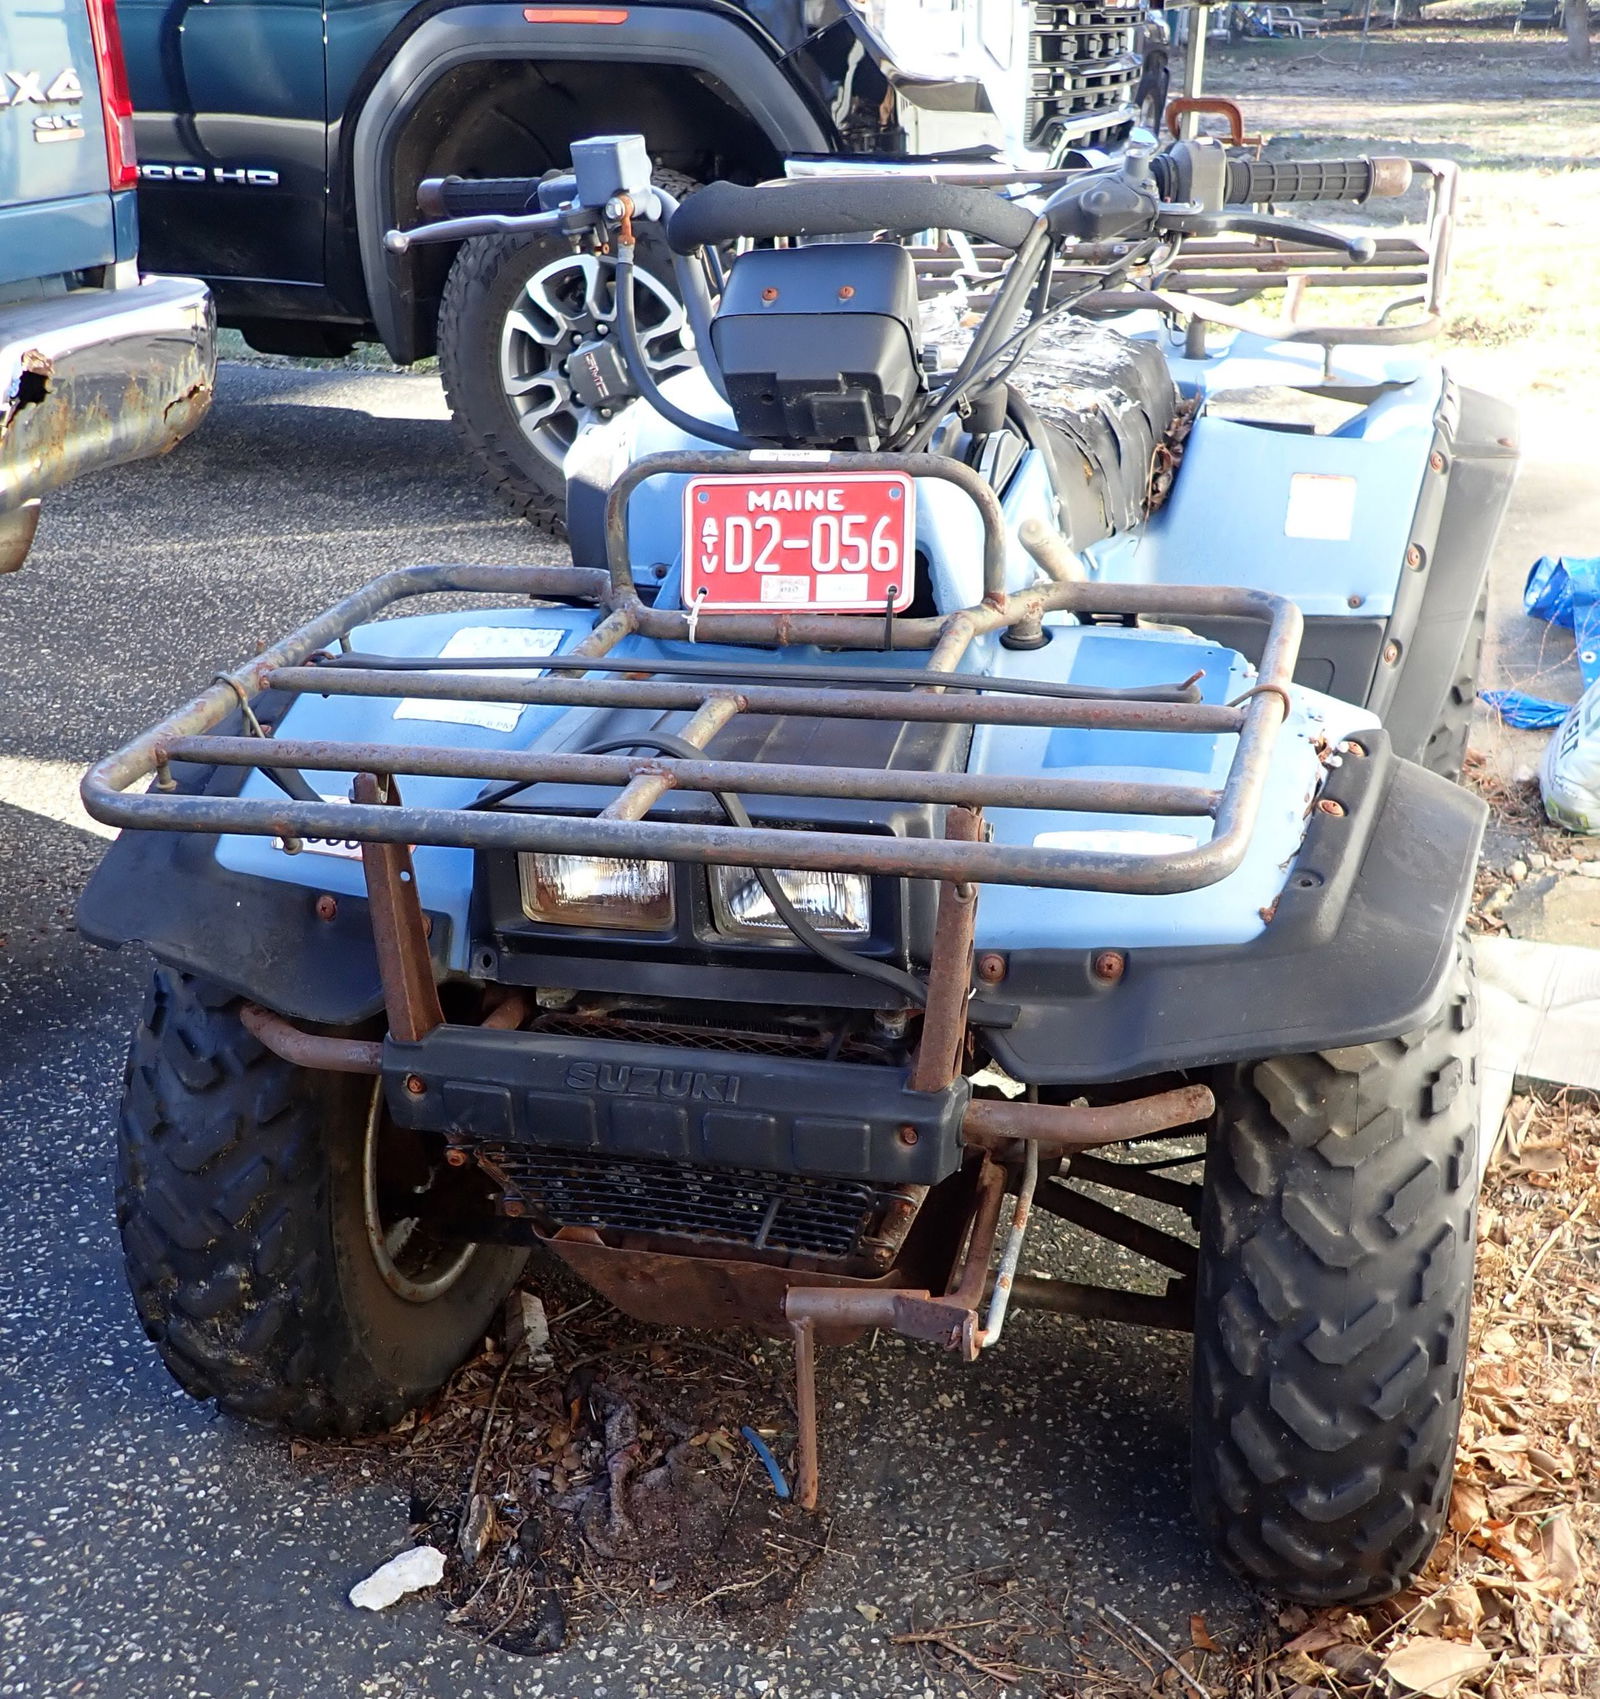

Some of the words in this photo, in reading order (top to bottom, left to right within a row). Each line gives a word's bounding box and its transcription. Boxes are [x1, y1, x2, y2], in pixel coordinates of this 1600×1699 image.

[213, 168, 279, 185] HD
[584, 352, 609, 398] GMC
[748, 489, 845, 512] MAINE
[702, 517, 719, 574] ATV
[724, 515, 898, 574] D2-056
[566, 1061, 741, 1104] SUZUKI
